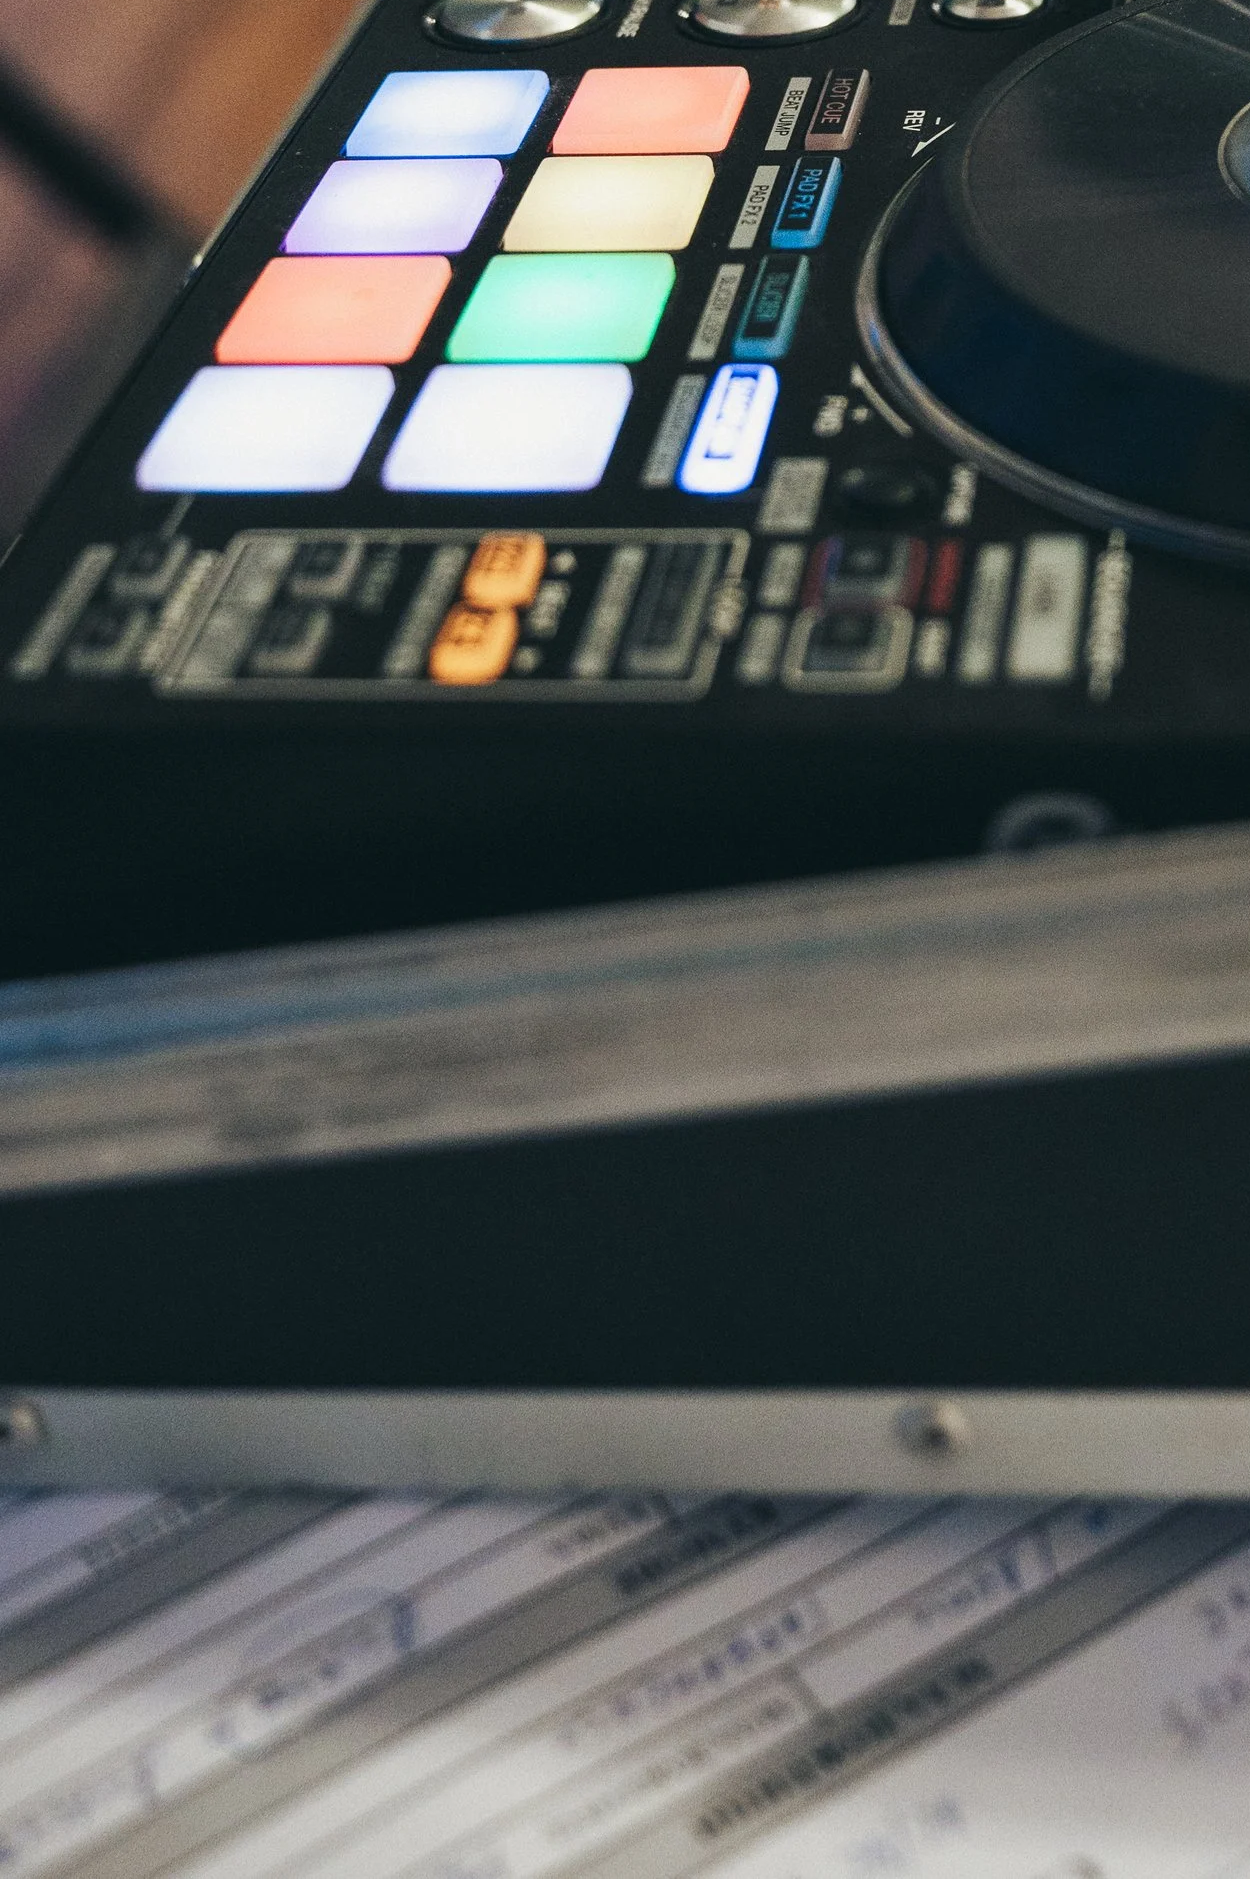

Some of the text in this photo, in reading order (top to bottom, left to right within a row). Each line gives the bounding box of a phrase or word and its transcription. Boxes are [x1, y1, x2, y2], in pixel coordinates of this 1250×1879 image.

[820, 78, 854, 124] HOT CUE
[775, 89, 805, 137] BEAT JUMP
[902, 110, 926, 132] REV
[797, 169, 823, 192] PAD
[750, 185, 770, 206] PAD
[791, 194, 815, 210] FX
[744, 205, 762, 218] FX
